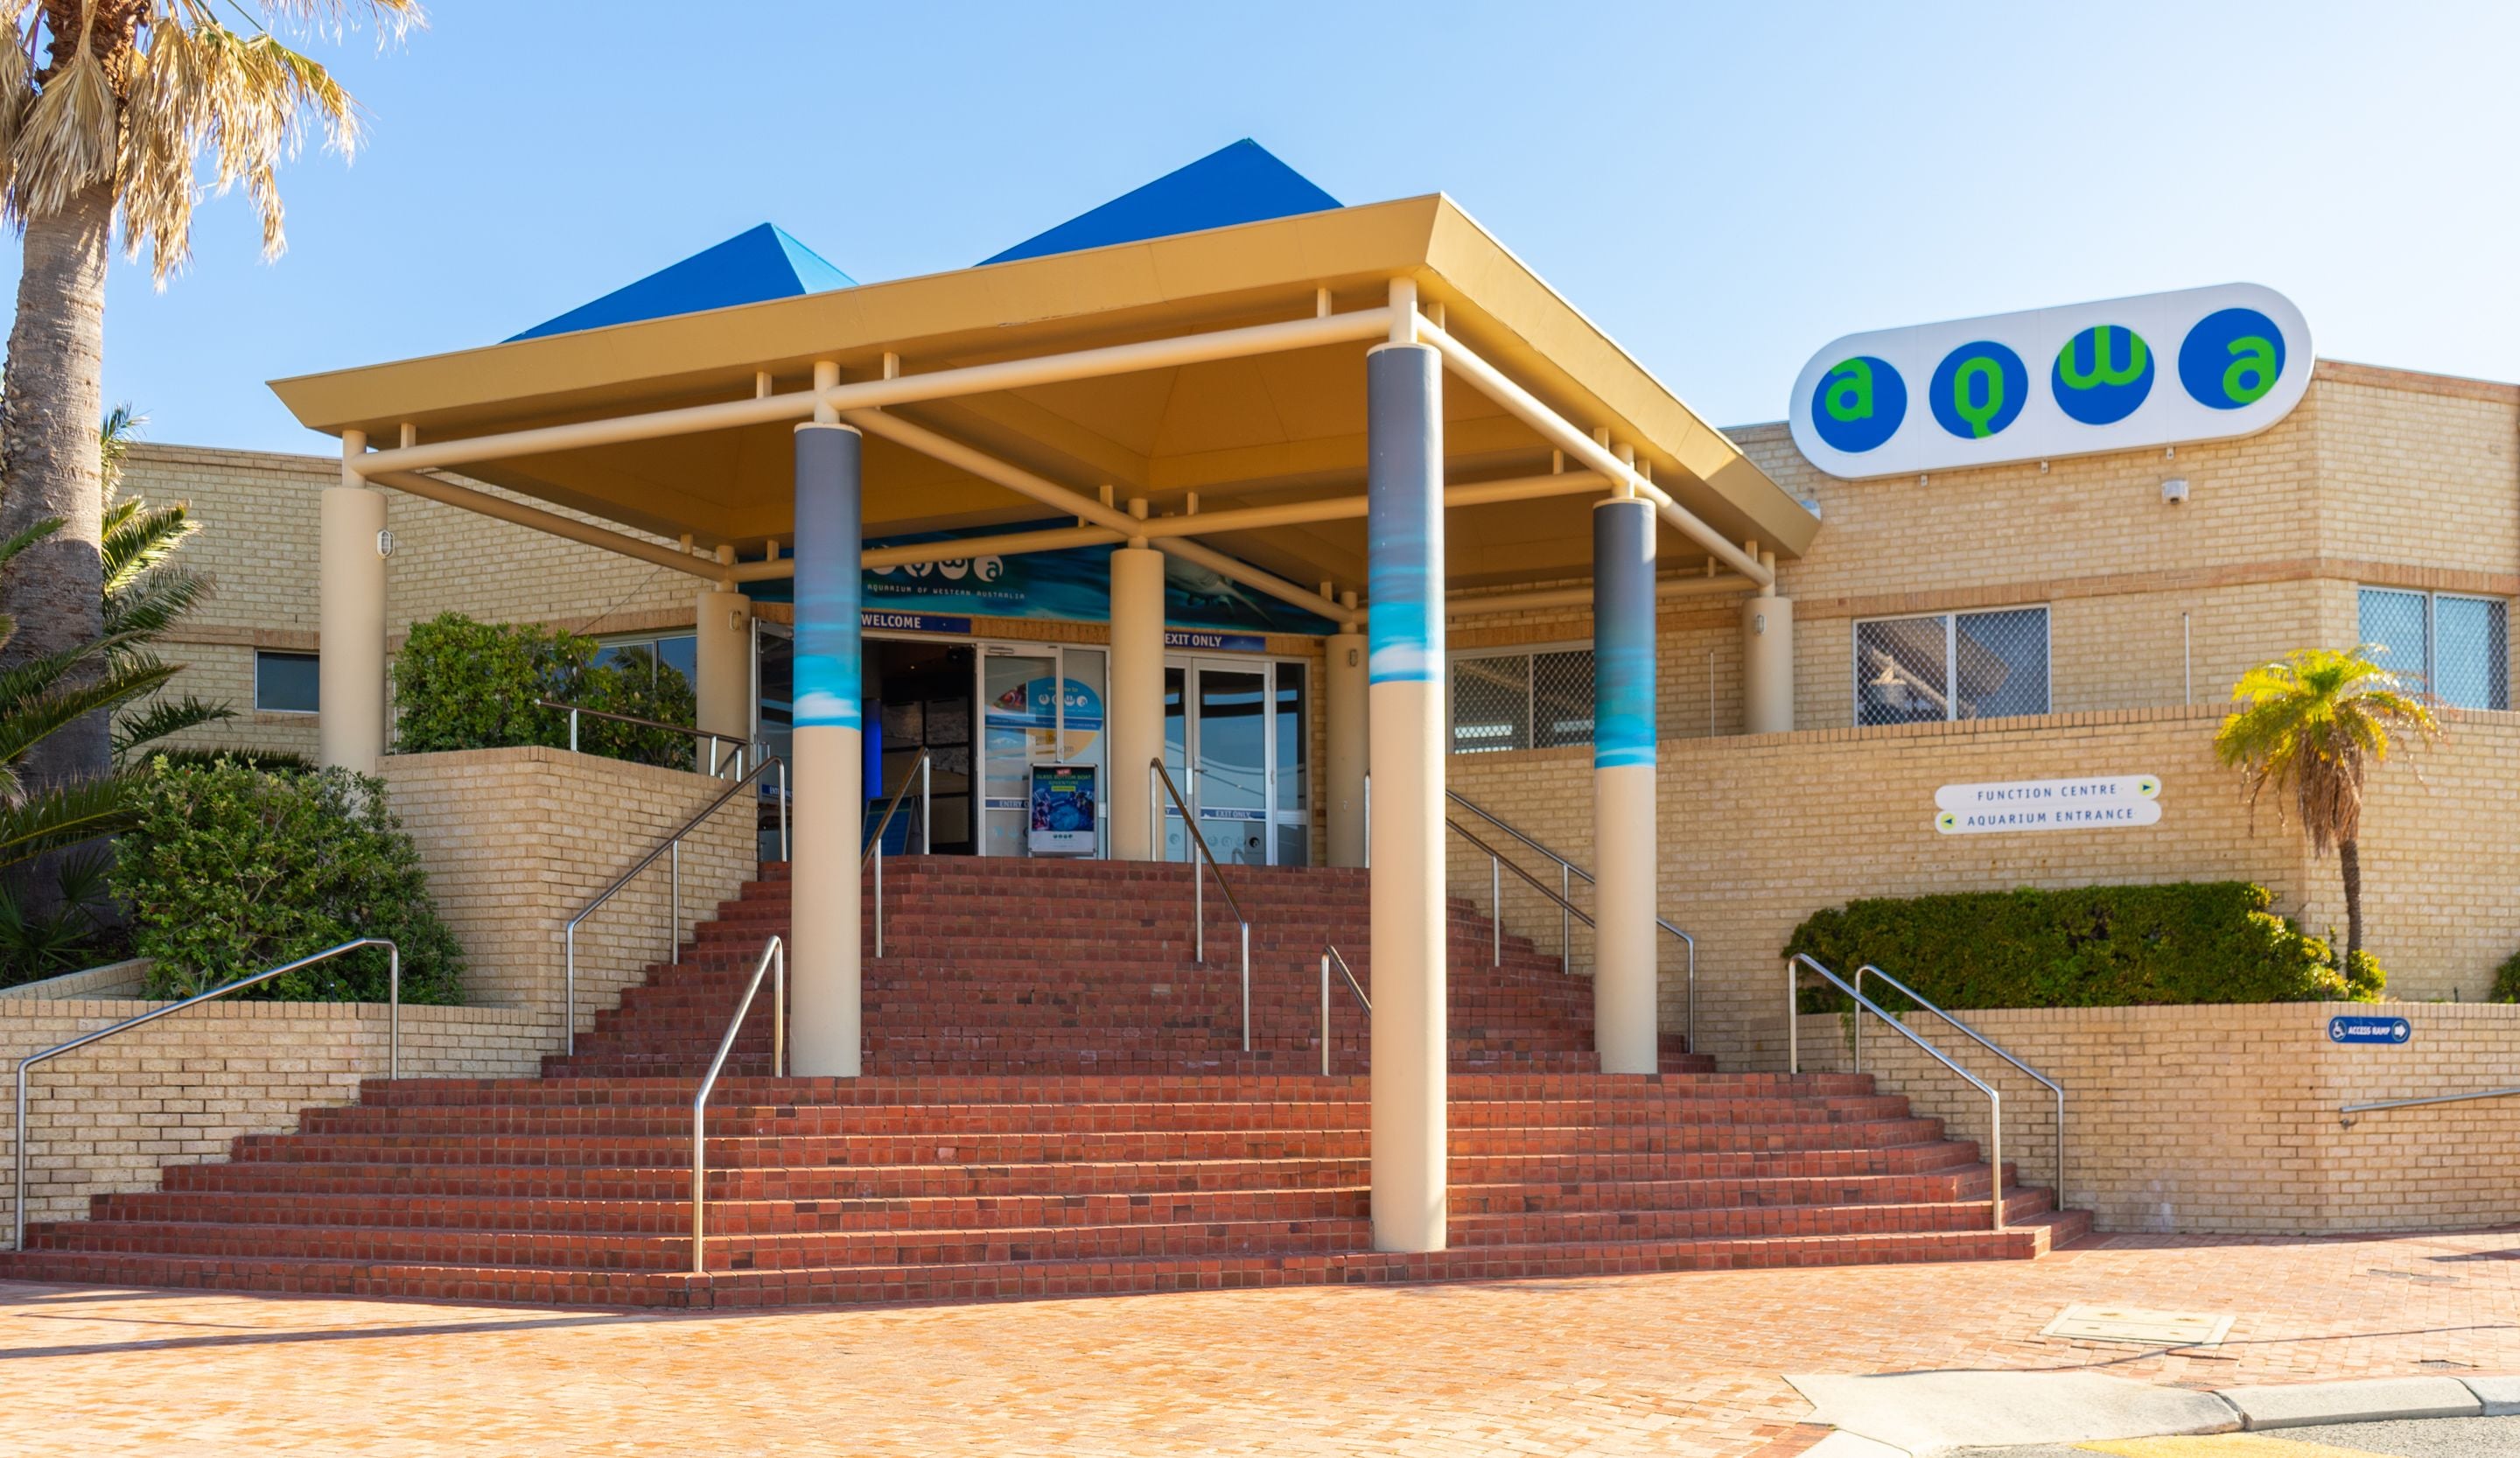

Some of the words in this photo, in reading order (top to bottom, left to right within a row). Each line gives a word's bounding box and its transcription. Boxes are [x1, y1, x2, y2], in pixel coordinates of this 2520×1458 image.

[867, 584, 912, 593] AQUARIUM
[976, 591, 1025, 599] AUSTRALIA
[861, 614, 921, 628] WELCOME
[1165, 634, 1189, 645] EXIT
[1192, 634, 1222, 647] ONLY
[1978, 789, 2052, 801] FUNCTION
[2061, 784, 2117, 796] CENTRE
[1968, 813, 2047, 826] AQUARIUM
[2056, 809, 2133, 822] ENTRANCE
[2372, 1027, 2390, 1035] RAMP
